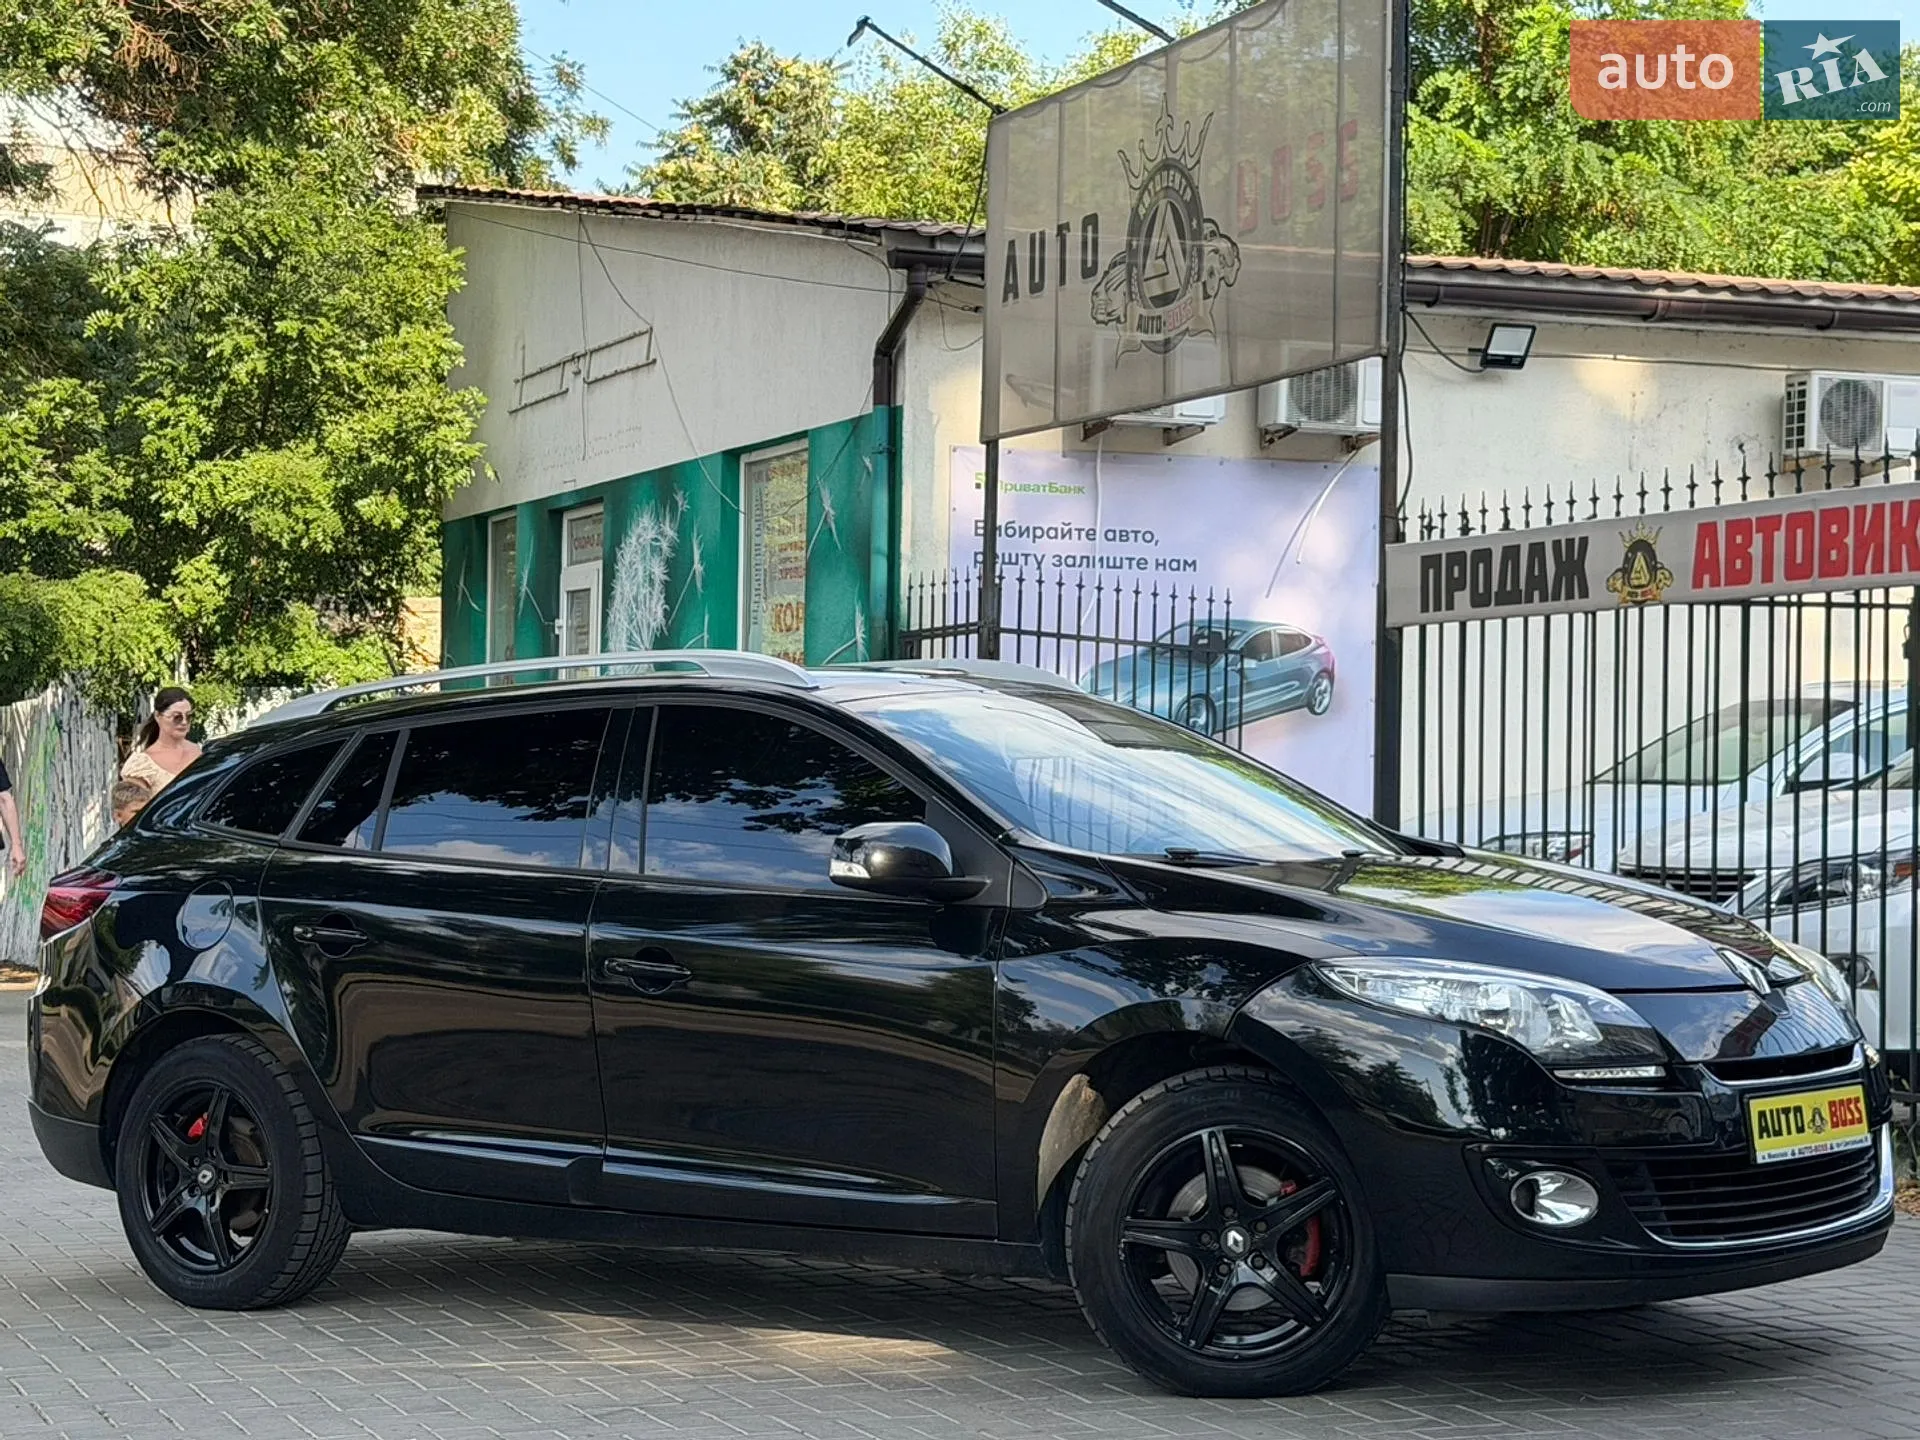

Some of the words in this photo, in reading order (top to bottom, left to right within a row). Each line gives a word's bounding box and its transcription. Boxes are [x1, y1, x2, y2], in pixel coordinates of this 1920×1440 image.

[1002, 211, 1099, 303] AUTO
[1237, 119, 1359, 234] BOSS
[1104, 528, 1160, 547] авто,
[1419, 535, 1590, 613] ПРОДАЖ
[1691, 499, 1920, 590] АВТОВИК
[974, 550, 1046, 570] ршту
[1051, 554, 1149, 571] залиште
[1155, 558, 1198, 572] нам
[1757, 1105, 1806, 1139] AUTO
[1828, 1096, 1864, 1129] BOSS
